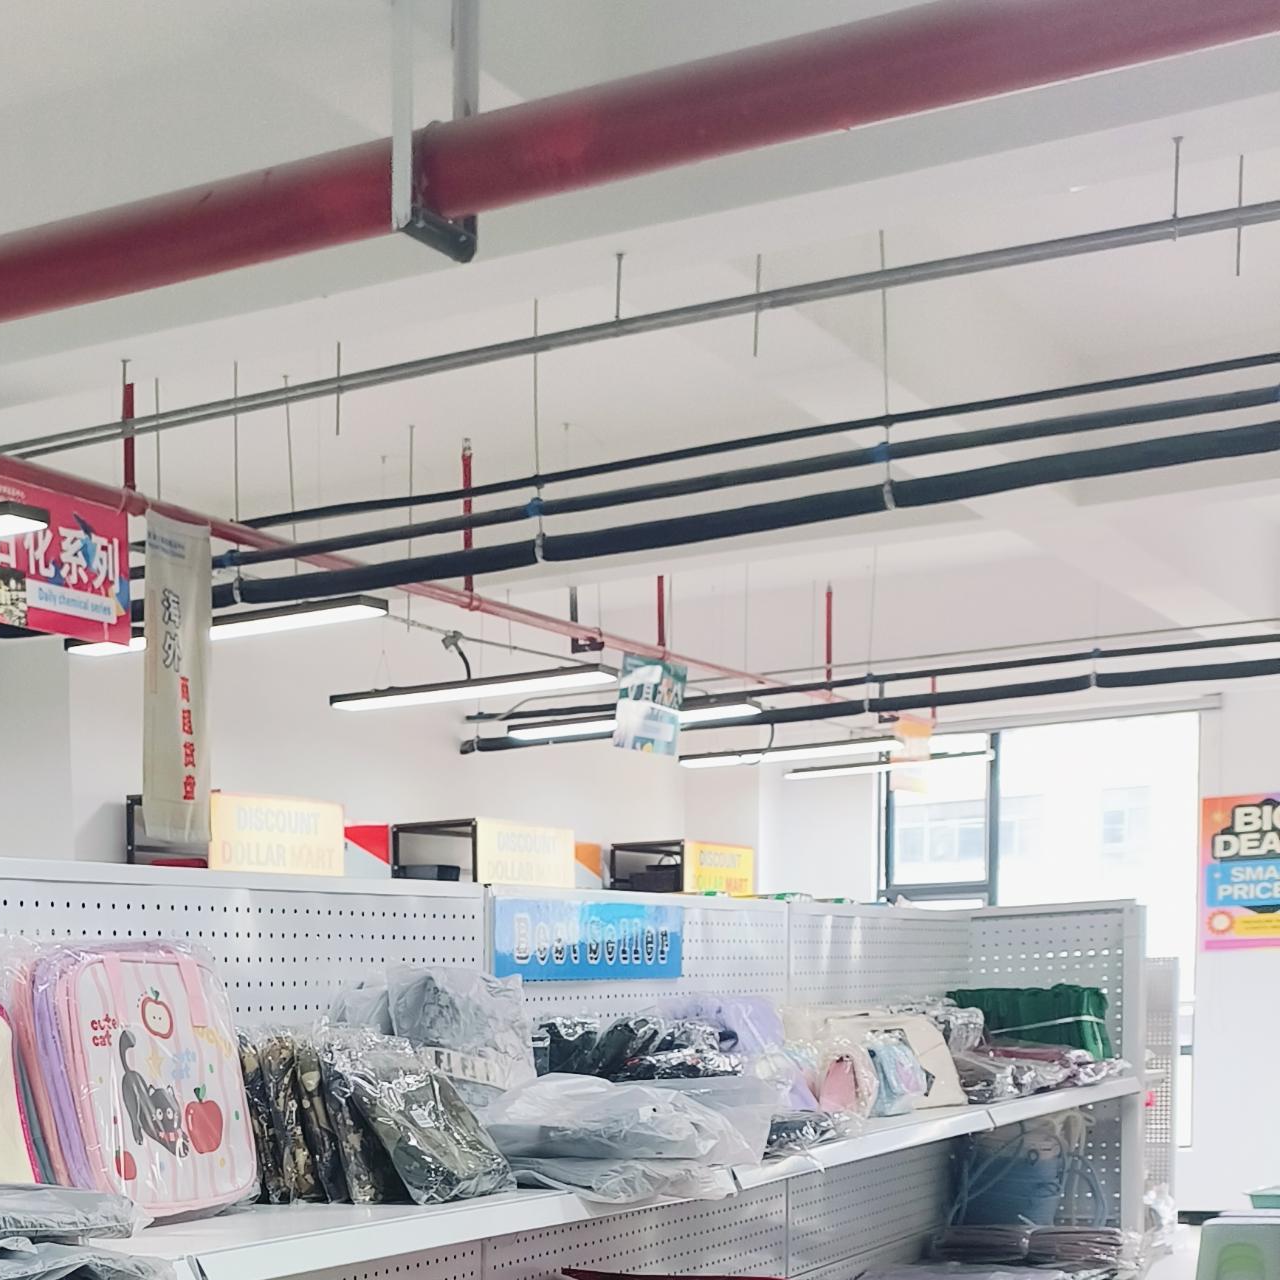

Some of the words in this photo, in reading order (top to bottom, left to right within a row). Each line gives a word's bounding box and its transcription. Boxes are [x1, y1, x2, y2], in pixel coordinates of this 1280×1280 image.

[236, 805, 321, 836] DISCOUNT
[221, 839, 287, 867] DOLLAR
[289, 843, 336, 870] MART
[92, 1030, 112, 1047] cat
